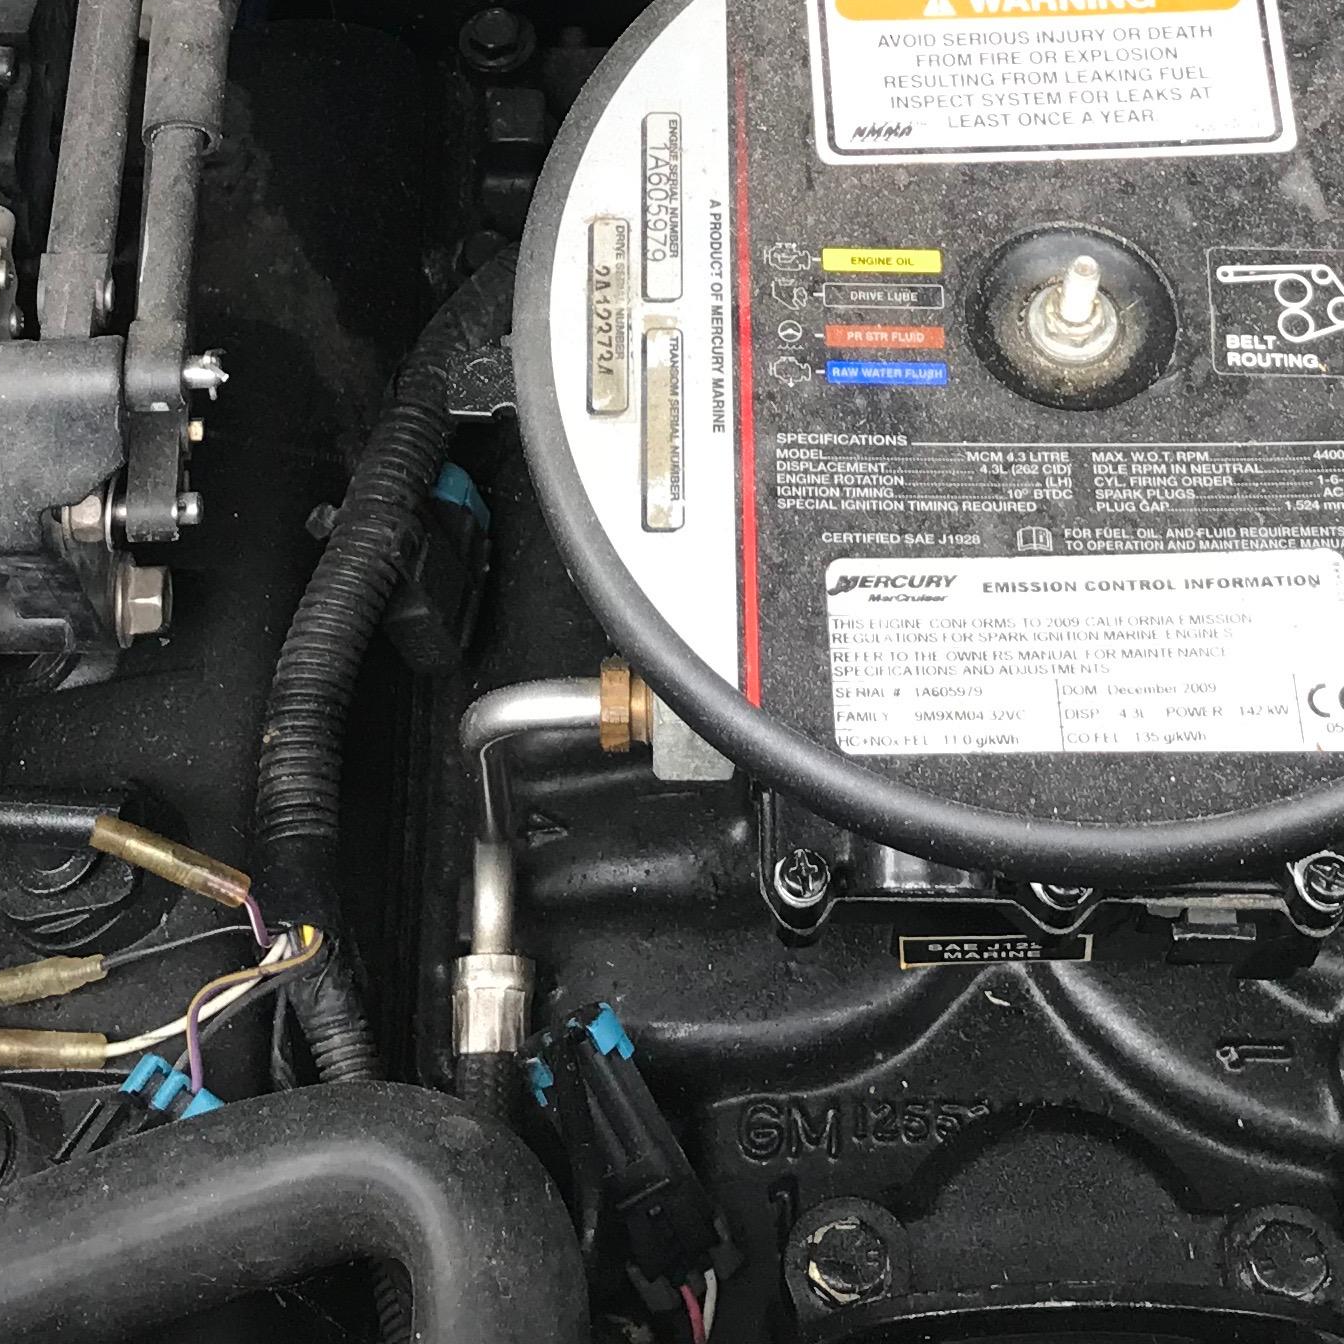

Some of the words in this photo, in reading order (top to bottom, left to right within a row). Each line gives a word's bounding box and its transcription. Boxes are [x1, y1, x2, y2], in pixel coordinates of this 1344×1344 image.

[878, 34, 936, 47] AVOID
[943, 31, 1029, 46] SERIOUS
[1037, 29, 1104, 44] INJURY
[1113, 28, 1140, 41] OR
[1148, 26, 1212, 39] DEATH
[916, 53, 972, 67] FROM
[980, 52, 1022, 65] FIRE
[1030, 51, 1057, 64] OR
[1065, 47, 1177, 63] EXPLOSION
[884, 73, 994, 88] RESULTING
[1002, 72, 1057, 85] FROM
[1066, 67, 1152, 83] LEAKING
[1160, 66, 1208, 80] FUEL
[891, 94, 973, 108] INSPECT
[982, 92, 1061, 106] SYSTEM
[1069, 90, 1108, 104] FOR
[1117, 88, 1182, 103] LEAKS
[1190, 87, 1211, 100] AT
[948, 114, 1010, 128] LEAST
[1019, 112, 1072, 126] ONCE
[1082, 112, 1092, 124] A
[1101, 109, 1154, 123] YEAR
[669, 119, 678, 162] ENGINE
[669, 164, 679, 204] SERIAL
[647, 143, 670, 262] 1A605979
[709, 200, 721, 208] A
[669, 207, 679, 258] NUMBER
[710, 213, 723, 277] PRODUCT
[851, 256, 892, 266] ENGINE
[896, 257, 914, 266] OIL
[711, 282, 723, 301] OF
[851, 291, 883, 301] DRIVE
[888, 292, 918, 302] LUBE
[615, 308, 625, 360] NUMBER
[711, 305, 724, 374] MERCURY
[847, 331, 863, 341] PR
[866, 331, 888, 341] STR
[892, 331, 924, 342] FLUID
[1226, 334, 1276, 350] BELT
[670, 336, 679, 395] TRANSOM
[1227, 352, 1318, 369] ROUTING
[832, 367, 858, 377] RAW
[863, 367, 901, 377] WATER
[906, 368, 943, 378] FLUSH
[712, 378, 725, 433] MARINE
[670, 398, 679, 442] SERIAL
[776, 433, 908, 446] SPECIFICATIONS
[776, 449, 824, 460] MODEL
[967, 451, 1003, 462] MCM
[1007, 452, 1026, 462] 4.3
[1029, 452, 1069, 462] LITRE
[1092, 451, 1127, 462] MAX.
[1176, 451, 1209, 462] RPM
[1313, 449, 1344, 460] 4400
[670, 446, 680, 501] NUMBER
[777, 461, 886, 473] DISPLACEMENT
[980, 464, 1007, 474] 4.3L
[1012, 464, 1039, 475] (262
[1042, 464, 1072, 475] CID)
[1093, 464, 1127, 475] IDLE
[1132, 464, 1167, 475] RPM
[1172, 464, 1187, 474] IN
[1191, 464, 1263, 474] NEUTRAL
[777, 474, 830, 485] ENGINE
[834, 475, 904, 486] ROTATION
[1046, 476, 1072, 488] (LH)
[1130, 476, 1179, 487] FIRING
[1184, 476, 1233, 486] ORDER
[777, 487, 840, 498] IGNITION
[843, 487, 894, 499] TIMING
[1034, 489, 1073, 500] BTDC
[1095, 489, 1143, 500] SPARK
[1146, 489, 1195, 500] PLUGS
[777, 499, 837, 510] SPECIAL
[841, 500, 904, 510] IGNITION
[908, 501, 958, 512] TIMING
[962, 501, 1037, 512] REQUIRED
[1097, 501, 1136, 512] PLUG
[1140, 501, 1169, 512] GAP
[1285, 500, 1319, 511] 1.524
[822, 533, 900, 544] CERTIFIED
[905, 533, 934, 544] SAE
[939, 534, 981, 545] J1928
[1064, 529, 1090, 540] FOR
[1166, 528, 1193, 539] AND
[1197, 527, 1236, 538] FLUID
[1066, 540, 1083, 550] TO
[1087, 540, 1164, 550] OPERATION
[1168, 539, 1195, 550] AND
[1199, 539, 1301, 550] MAINTENANCE
[827, 574, 958, 596] MERCURY
[983, 581, 1077, 593] EMISSION
[1085, 579, 1176, 592] CONTROL
[1184, 574, 1321, 590] INFORMATION
[832, 618, 864, 629] THIS
[930, 618, 1016, 629] CONFORMS
[1024, 617, 1041, 628] TO
[1085, 615, 1174, 627] CALIFORNIA
[1178, 613, 1252, 625] EMISSION
[832, 632, 937, 644] REGULATIONS
[942, 632, 973, 643] FOR
[978, 631, 1028, 642] SPARK
[1033, 630, 1098, 641] IGNITION
[1103, 629, 1158, 640] MARINE
[890, 651, 908, 662] TO
[915, 651, 937, 661] THE
[946, 650, 1013, 661] OWNERS
[1018, 649, 1077, 661] MANUAL
[963, 665, 994, 676] AND
[835, 687, 885, 698] SERIAL
[915, 686, 983, 698] 1A605979
[1062, 685, 1097, 695] DOM
[1108, 683, 1177, 695] December
[1184, 683, 1217, 694] 2009
[836, 711, 889, 722] FAMILY
[1167, 706, 1224, 718] POWER
[736, 1104, 840, 1165] GM
